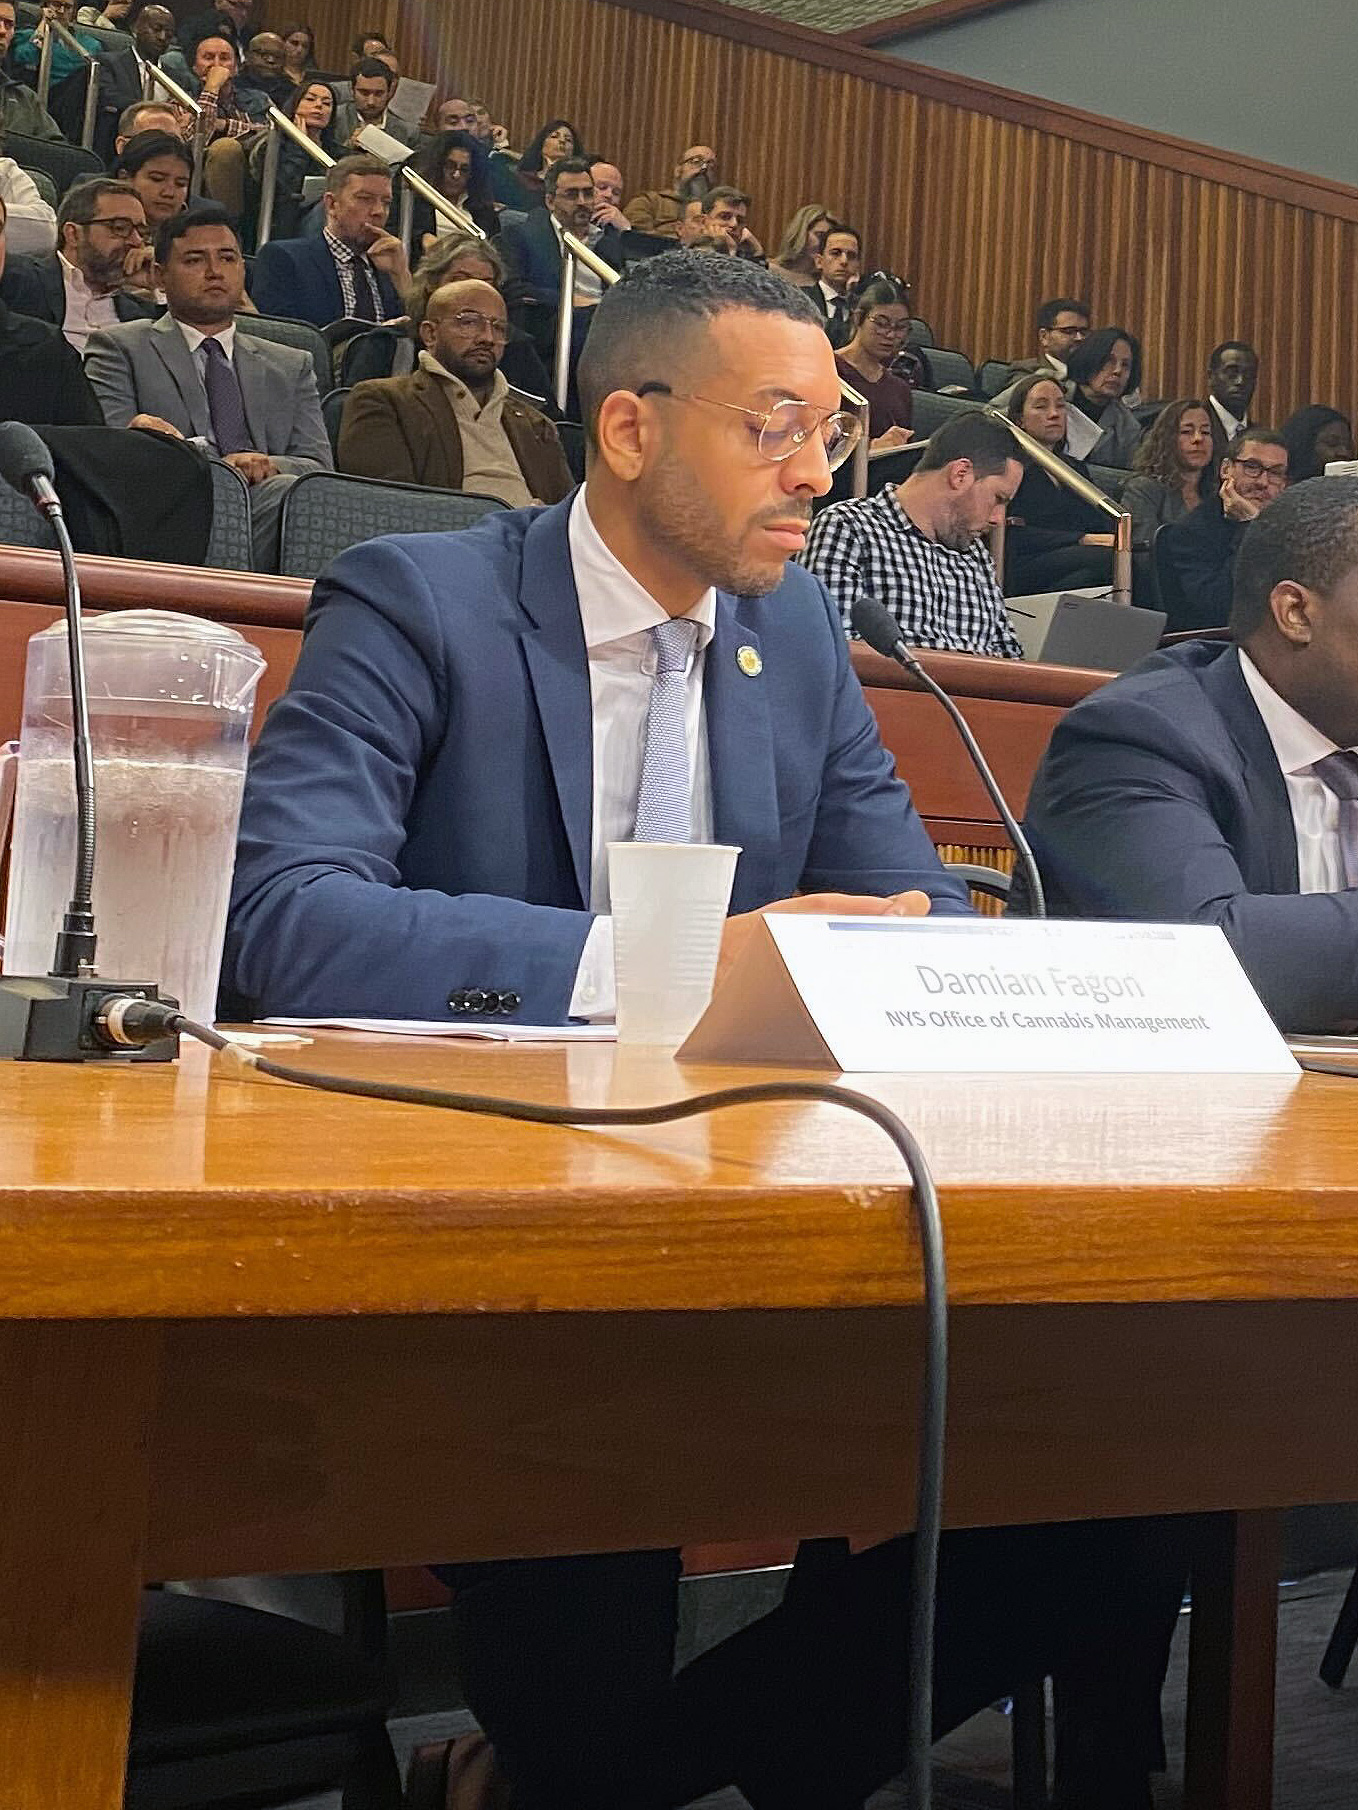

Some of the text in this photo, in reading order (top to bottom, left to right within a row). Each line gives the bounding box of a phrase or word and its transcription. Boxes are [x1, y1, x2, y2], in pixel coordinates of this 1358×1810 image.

[915, 965, 1146, 1004] Damian Fagon
[885, 1010, 1211, 1033] NYS Office of Cannabis Management
